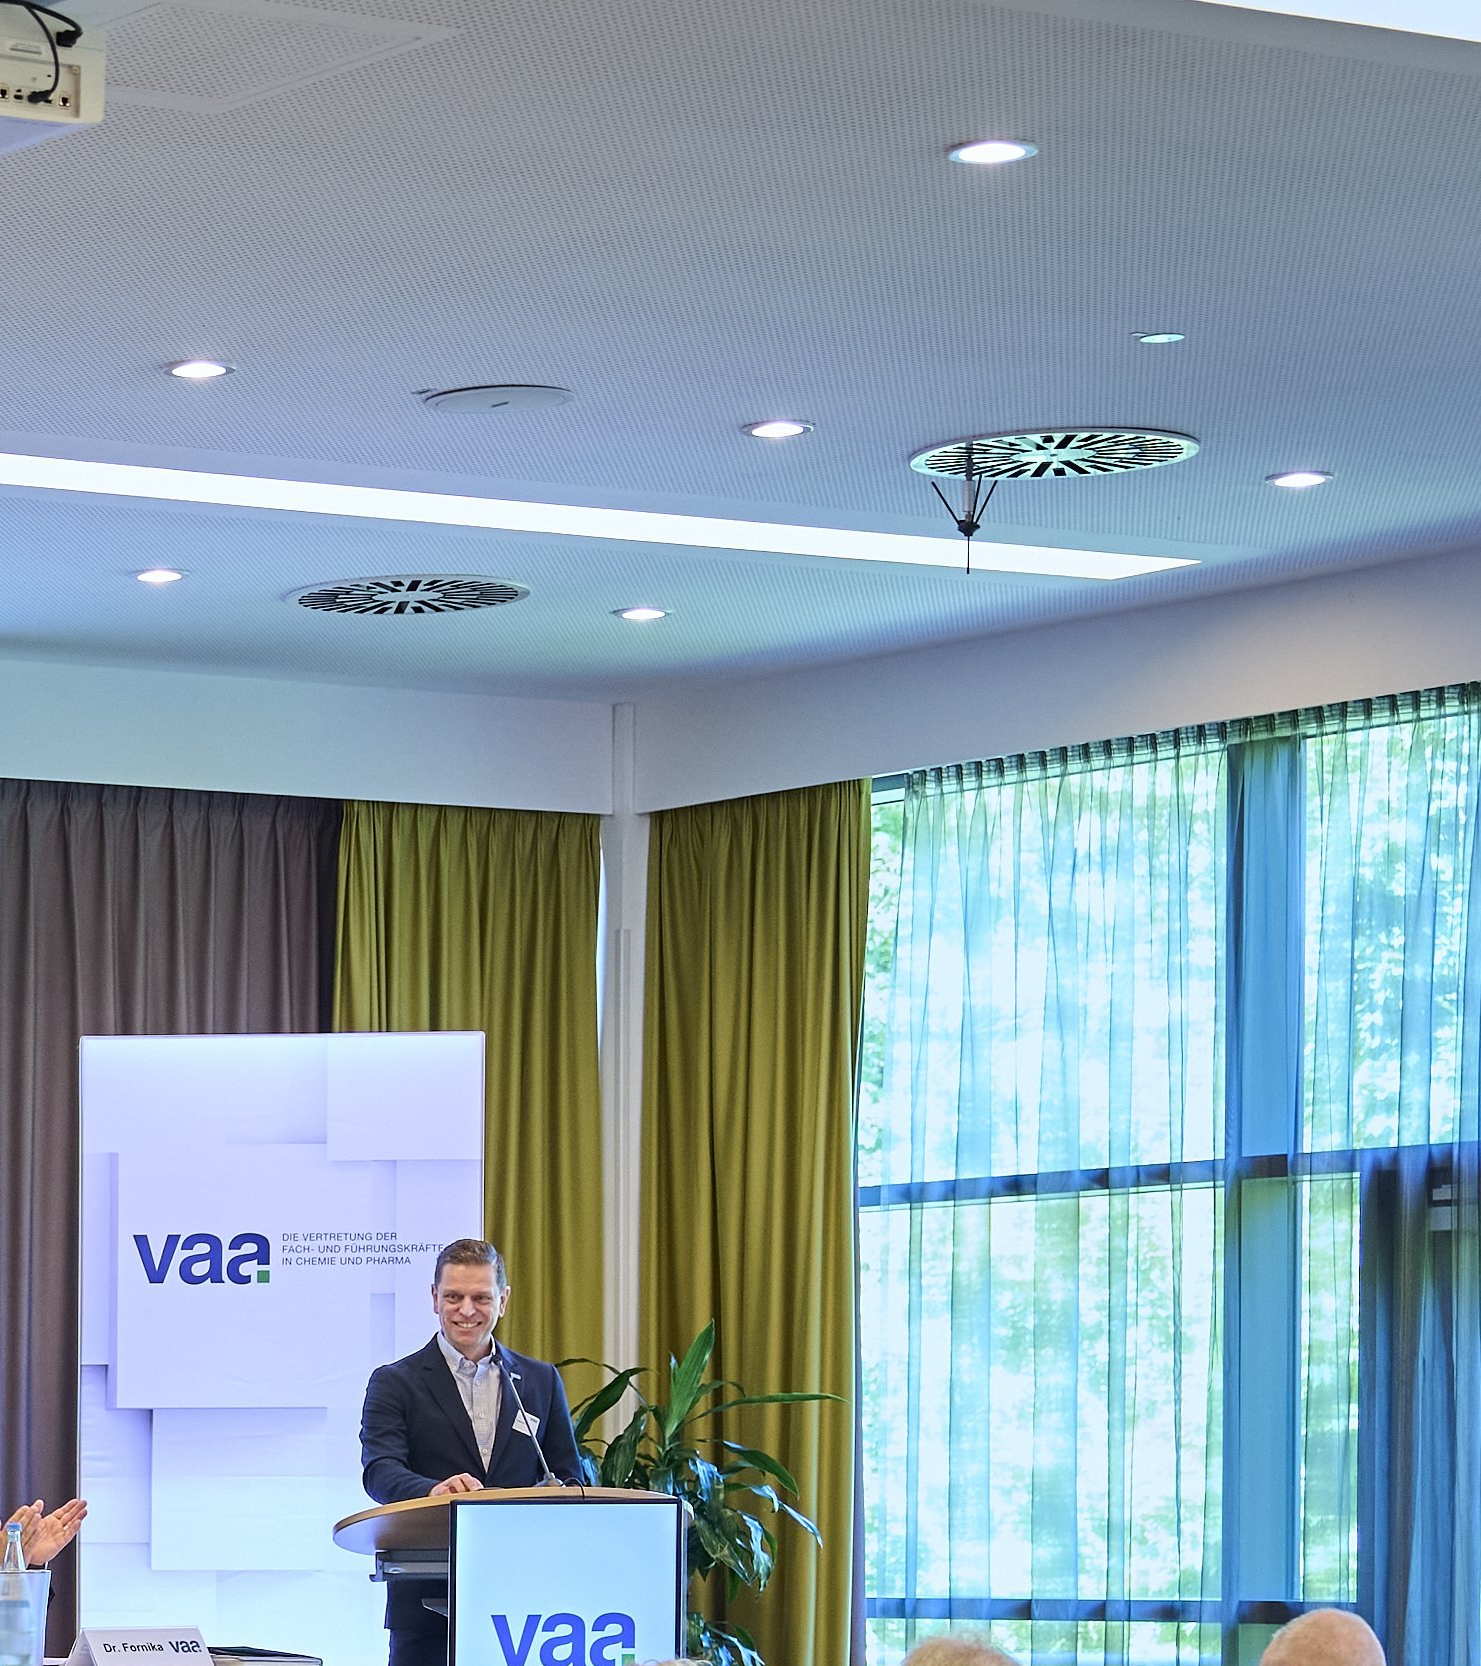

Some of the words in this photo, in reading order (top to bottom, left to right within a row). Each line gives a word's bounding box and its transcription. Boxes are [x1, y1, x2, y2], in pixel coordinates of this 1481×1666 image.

[282, 1232, 299, 1242] DIE
[302, 1232, 373, 1242] VERTRETUNG
[376, 1232, 397, 1241] DER
[282, 1244, 315, 1254] FACH-
[318, 1244, 341, 1254] UND
[133, 1232, 270, 1285] vaa
[282, 1257, 292, 1266] IN
[296, 1257, 337, 1266] CHEMIE
[340, 1256, 363, 1265] UND
[366, 1256, 411, 1265] PHARMA
[103, 1643, 121, 1653] Dr.
[122, 1642, 164, 1652] Fornika
[169, 1640, 202, 1653] vaa
